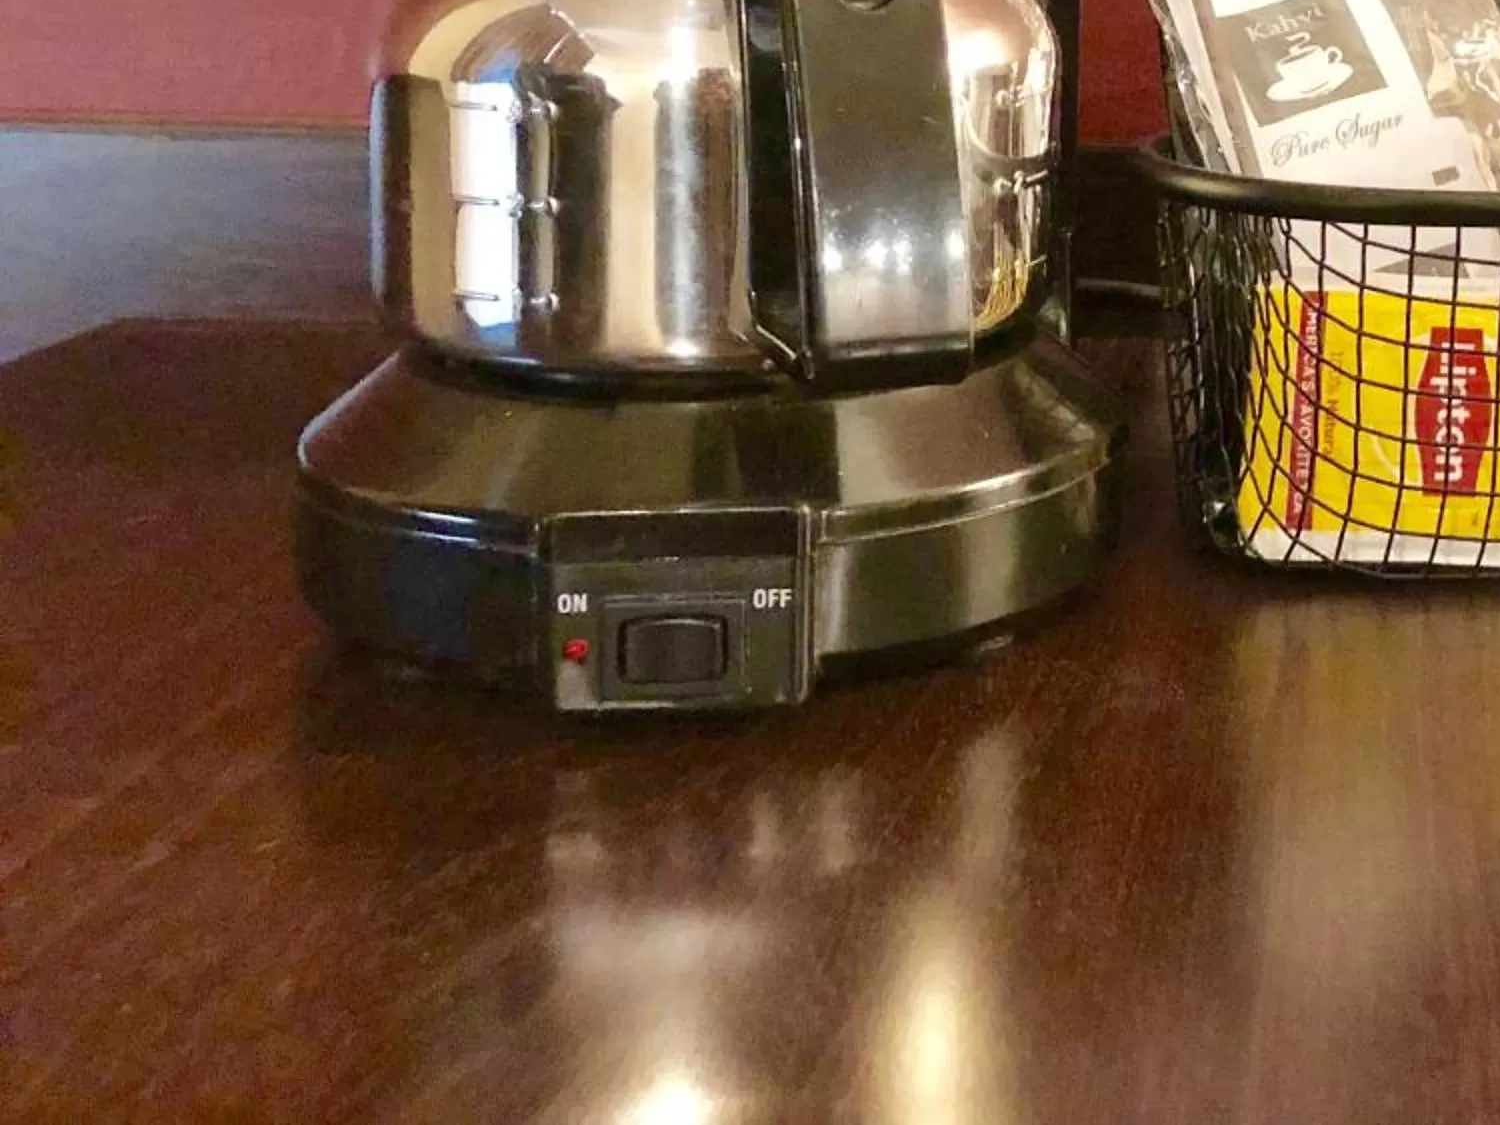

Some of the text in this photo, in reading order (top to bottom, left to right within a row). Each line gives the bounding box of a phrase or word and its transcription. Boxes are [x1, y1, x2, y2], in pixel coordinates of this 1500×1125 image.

[1244, 2, 1325, 43] Kahvi
[1271, 112, 1403, 167] Pure Sugar
[1302, 301, 1320, 393] AMERCA'S
[1297, 396, 1316, 479] AVORITE
[1322, 399, 1341, 458] Natura
[1429, 341, 1477, 482] Lipton
[557, 593, 588, 614] ON
[752, 588, 793, 609] OFF
